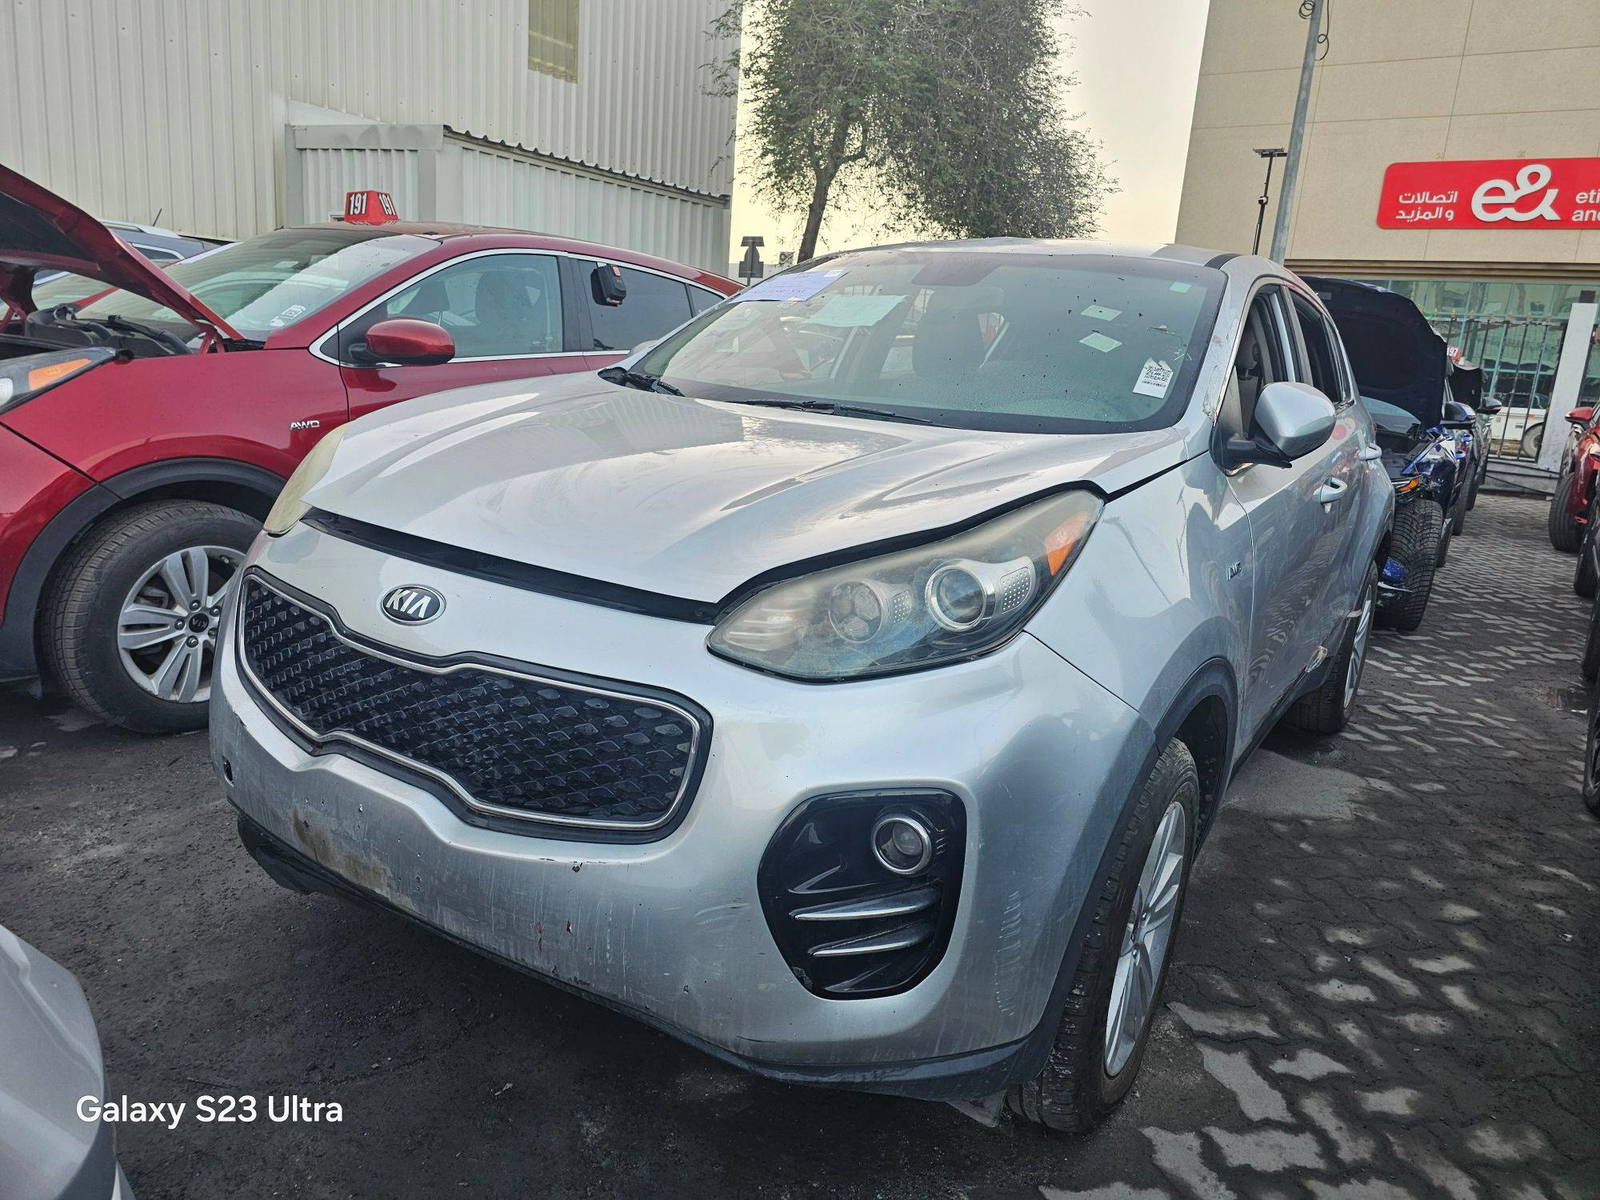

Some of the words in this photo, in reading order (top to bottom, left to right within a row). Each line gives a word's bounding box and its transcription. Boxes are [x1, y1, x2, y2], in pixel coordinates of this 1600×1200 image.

[350, 192, 367, 215] 191
[378, 192, 396, 215] 191
[1398, 190, 1459, 204] اتصالات
[1395, 206, 1455, 222] والمزيد
[290, 420, 320, 430] AWD
[385, 588, 432, 618] KIA
